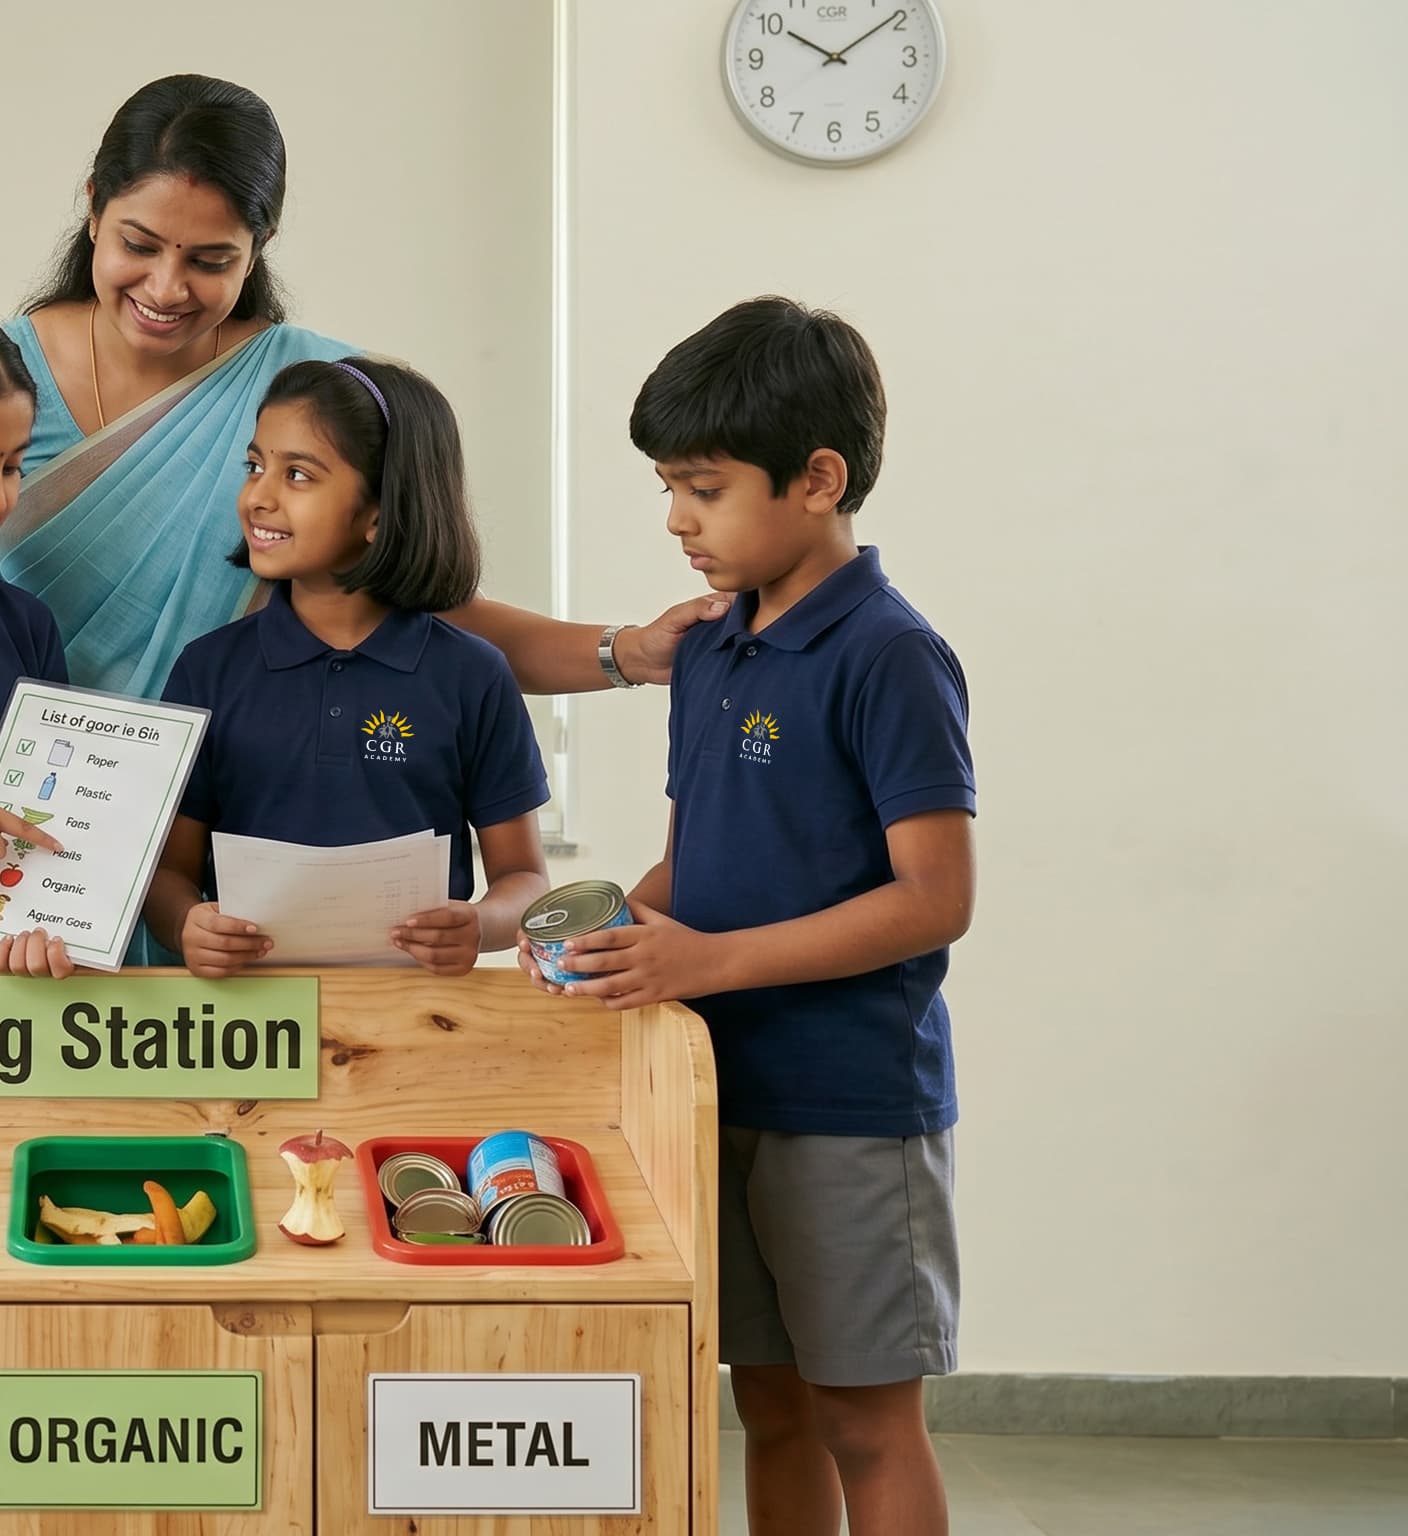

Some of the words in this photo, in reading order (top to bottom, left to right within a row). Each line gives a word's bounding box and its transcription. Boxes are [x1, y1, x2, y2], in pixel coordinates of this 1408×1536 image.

[816, 6, 847, 18] CGR
[893, 9, 907, 31] 2
[757, 12, 783, 35] 10
[748, 48, 764, 70] 9
[902, 46, 918, 68] 3
[760, 86, 775, 108] 8
[892, 83, 909, 104] 4
[789, 112, 804, 133] 7
[826, 121, 842, 143] 6
[865, 111, 881, 132] 5
[41, 708, 68, 724] List
[69, 715, 87, 727] of
[85, 719, 120, 733] goor
[122, 723, 135, 737] ie
[366, 739, 406, 755] CGR
[742, 738, 771, 757] CGR
[86, 754, 119, 768] Paper
[364, 754, 407, 763] ACADEMY
[75, 786, 112, 801] Plastic
[42, 878, 86, 895] Organic
[66, 917, 92, 930] Goes
[61, 1002, 300, 1070] Station
[10, 1417, 242, 1463] ORGANIC
[420, 1422, 589, 1466] METAL
